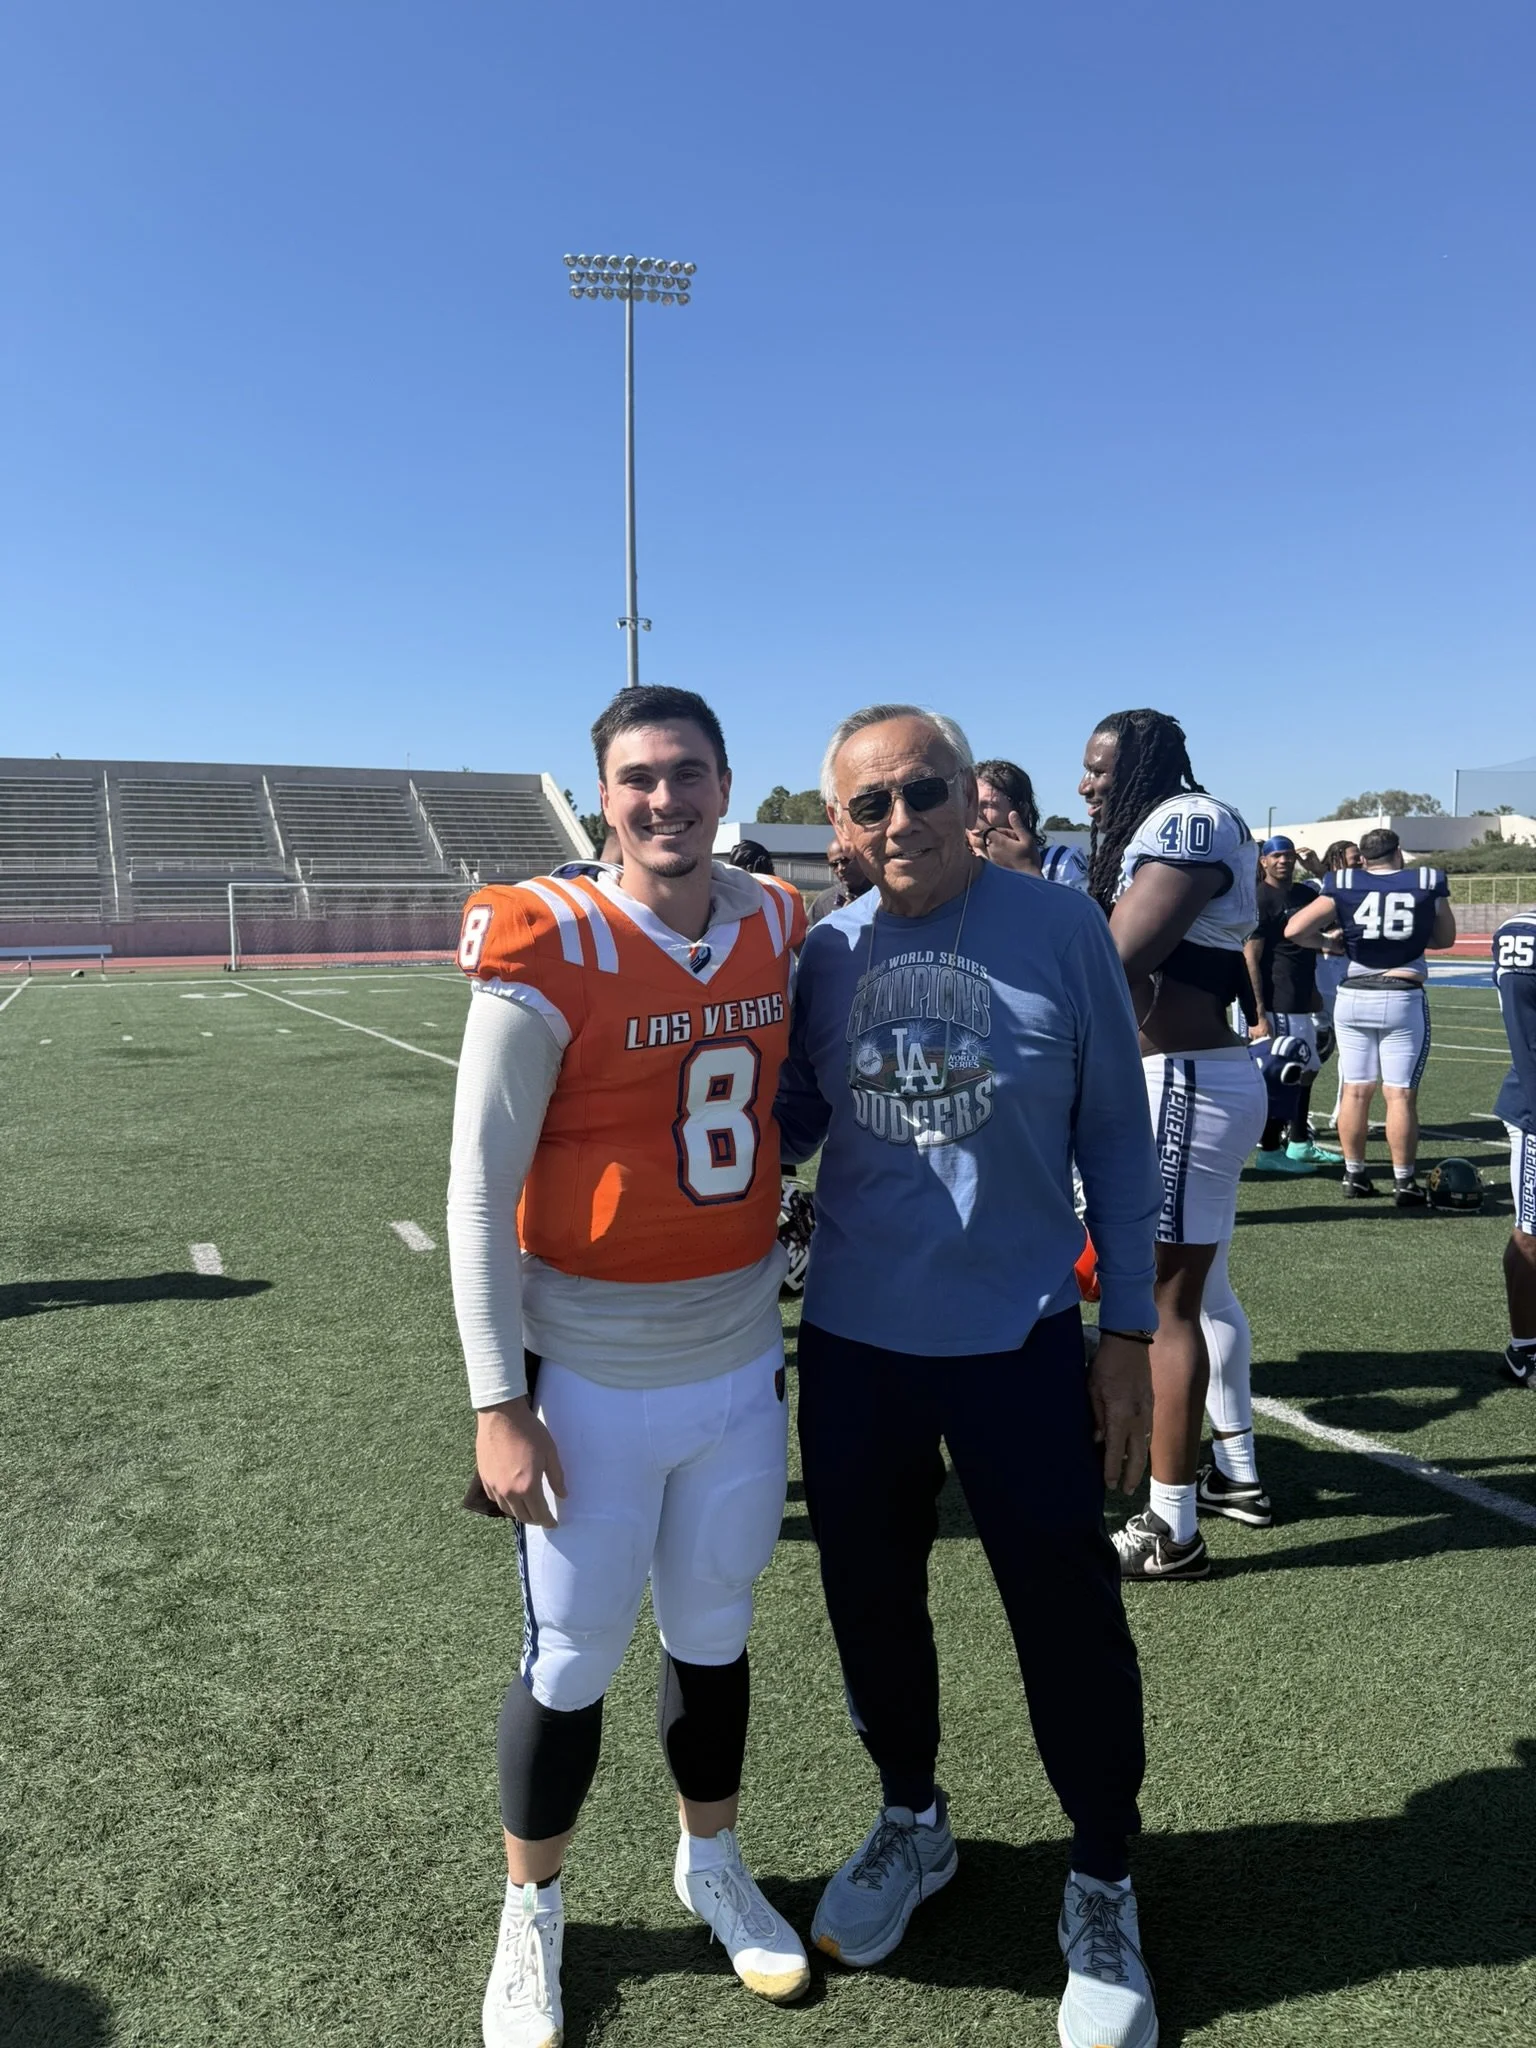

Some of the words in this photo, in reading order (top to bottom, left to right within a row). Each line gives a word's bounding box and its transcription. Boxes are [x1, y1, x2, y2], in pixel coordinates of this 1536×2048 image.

[1156, 813, 1214, 856] 40
[455, 904, 494, 973] 8
[1353, 891, 1415, 940] 46
[889, 950, 935, 969] WORLD
[939, 951, 988, 980] SERIES
[1498, 935, 1535, 967] 25
[624, 1010, 691, 1051] LAS
[702, 992, 785, 1037] VEGAS
[846, 964, 991, 1043] CHAMPIONS
[892, 1028, 938, 1093] LA
[947, 1061, 980, 1070] SERIES
[948, 1054, 978, 1062] WORLD
[672, 1036, 762, 1206] 8
[852, 1075, 995, 1144] DODGERS
[1163, 1088, 1188, 1146] PREP
[1523, 1132, 1536, 1186] SUPER
[1521, 1184, 1535, 1224] PREP
